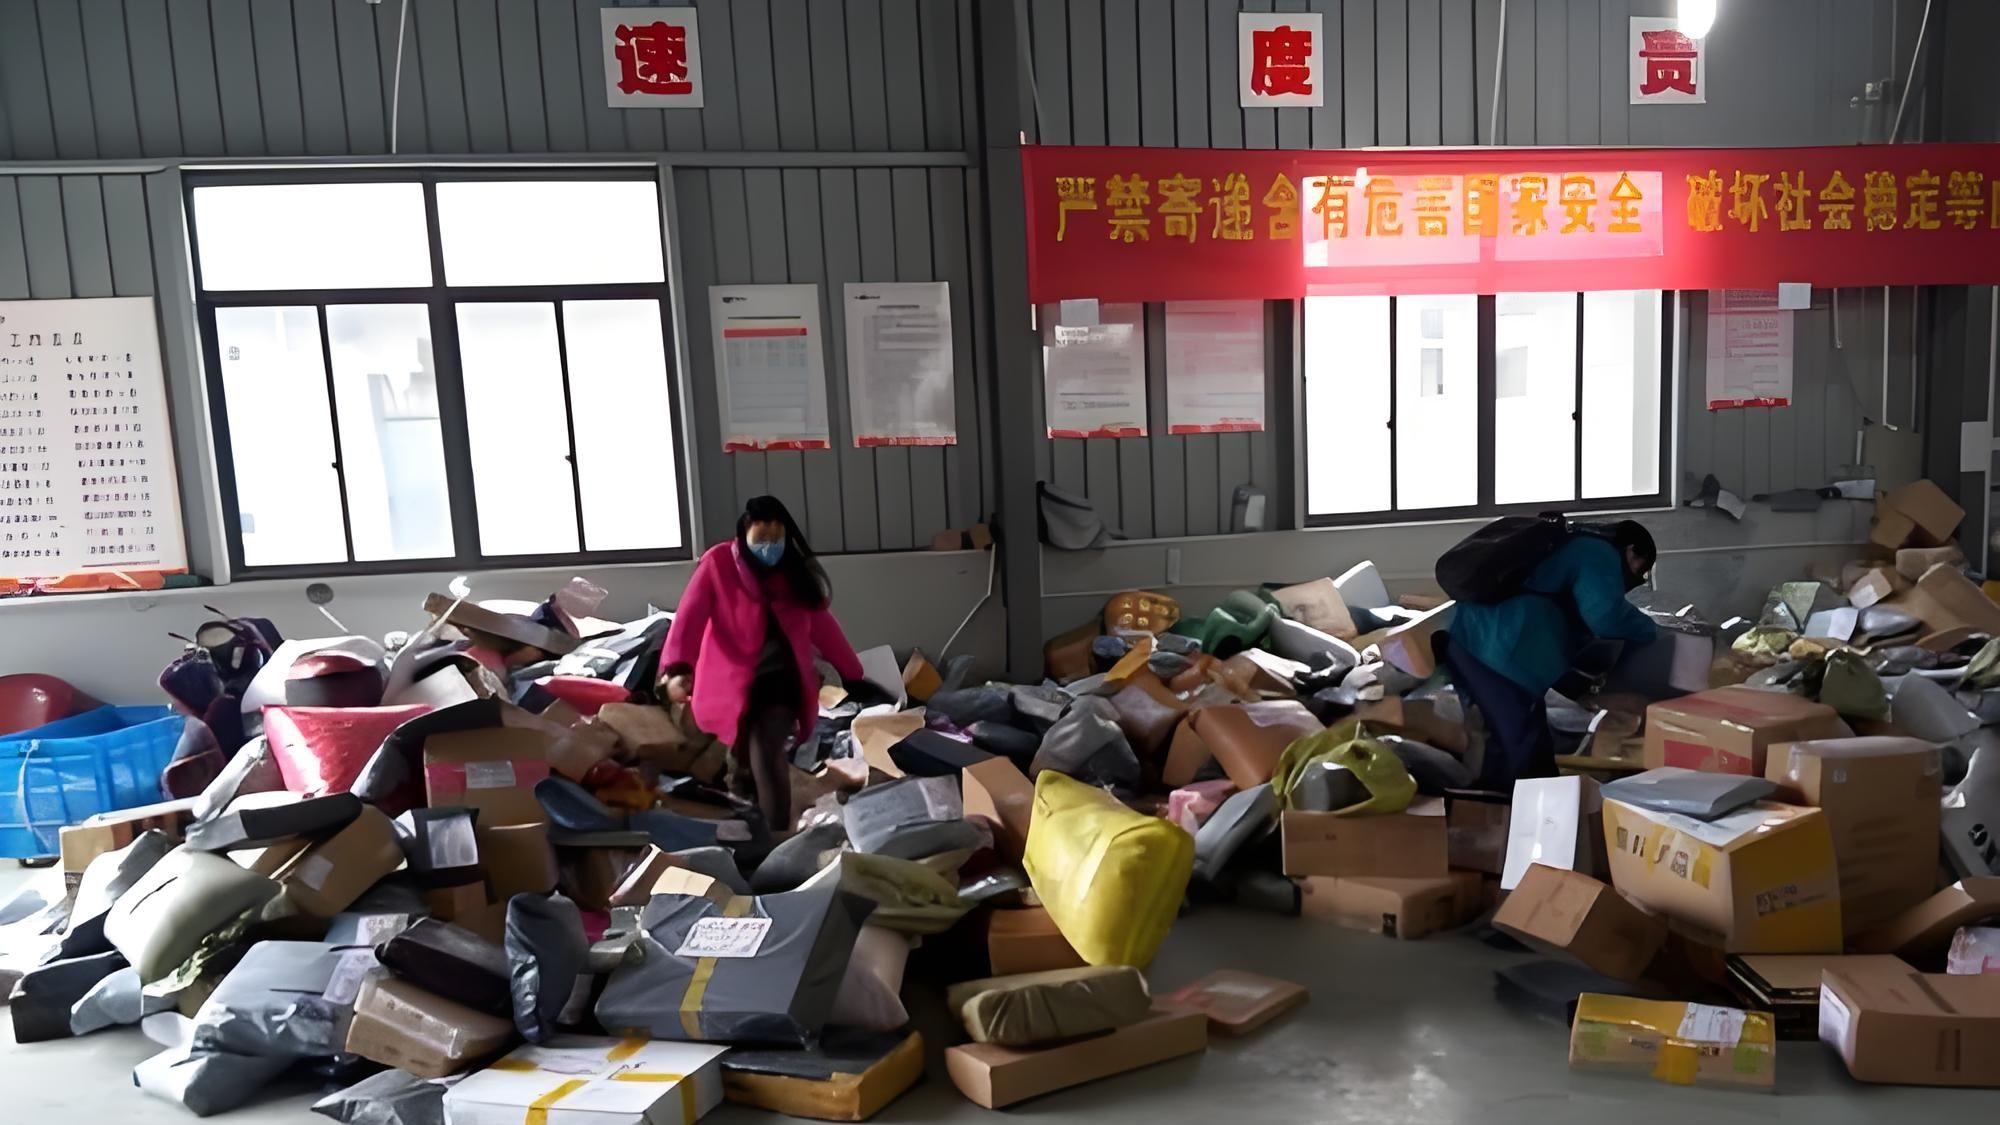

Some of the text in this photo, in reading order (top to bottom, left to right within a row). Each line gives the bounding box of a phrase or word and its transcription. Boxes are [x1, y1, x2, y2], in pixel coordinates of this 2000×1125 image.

[615, 21, 692, 95] 速
[1251, 25, 1313, 96] 度
[1686, 169, 2000, 232] 破坏社会稳定等
